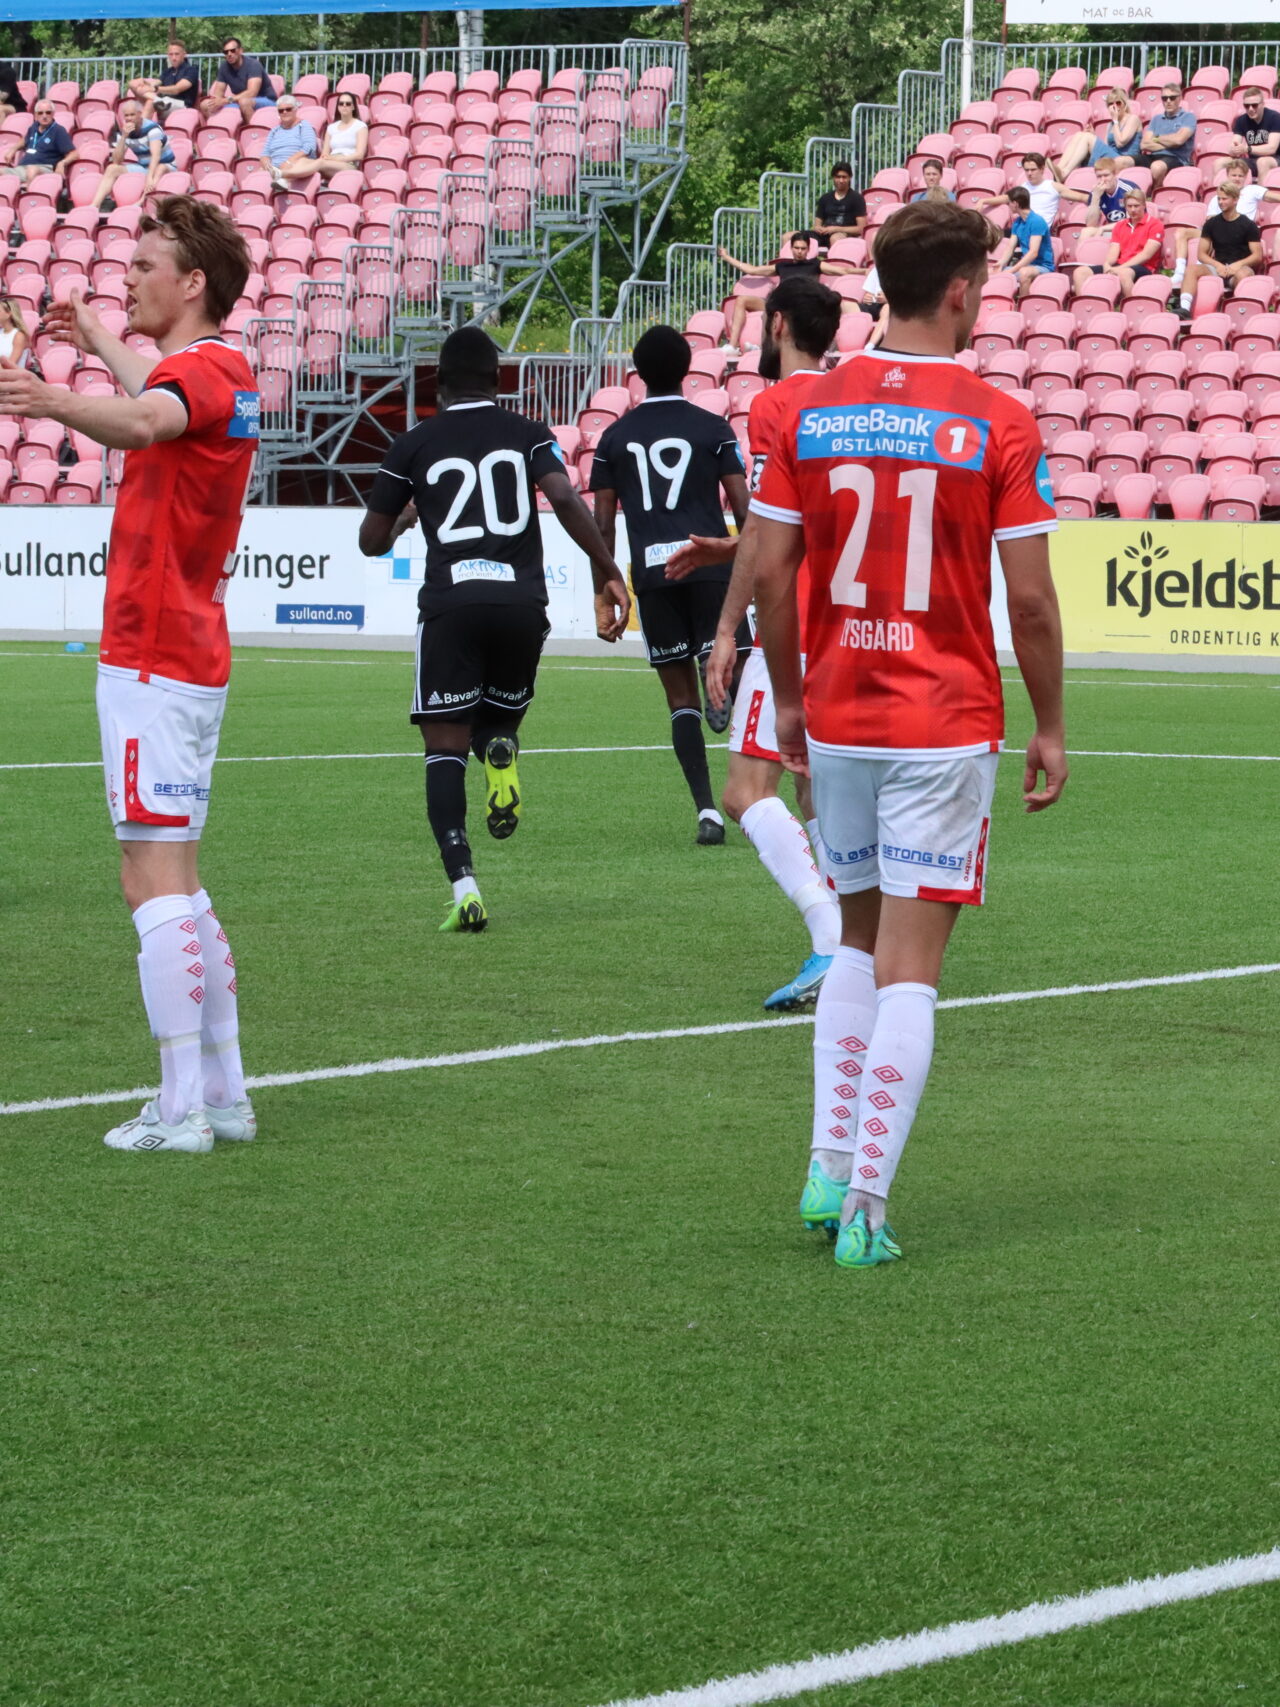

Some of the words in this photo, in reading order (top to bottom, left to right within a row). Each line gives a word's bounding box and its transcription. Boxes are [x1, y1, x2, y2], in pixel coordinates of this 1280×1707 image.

[1082, 8, 1108, 18] MAT
[1127, 7, 1153, 18] BAR
[802, 409, 932, 438] SpareBank
[949, 427, 967, 453] 1
[831, 438, 929, 456] ØSTLANDET
[626, 437, 692, 511] 19
[426, 449, 531, 544] 20
[829, 464, 938, 612] 21
[0, 541, 107, 577] ulland
[544, 565, 567, 584] AS
[289, 607, 353, 622] sulland.no
[1170, 629, 1262, 647] ORDENTLIG
[938, 854, 965, 868] ØST
[963, 850, 973, 882] umbro
